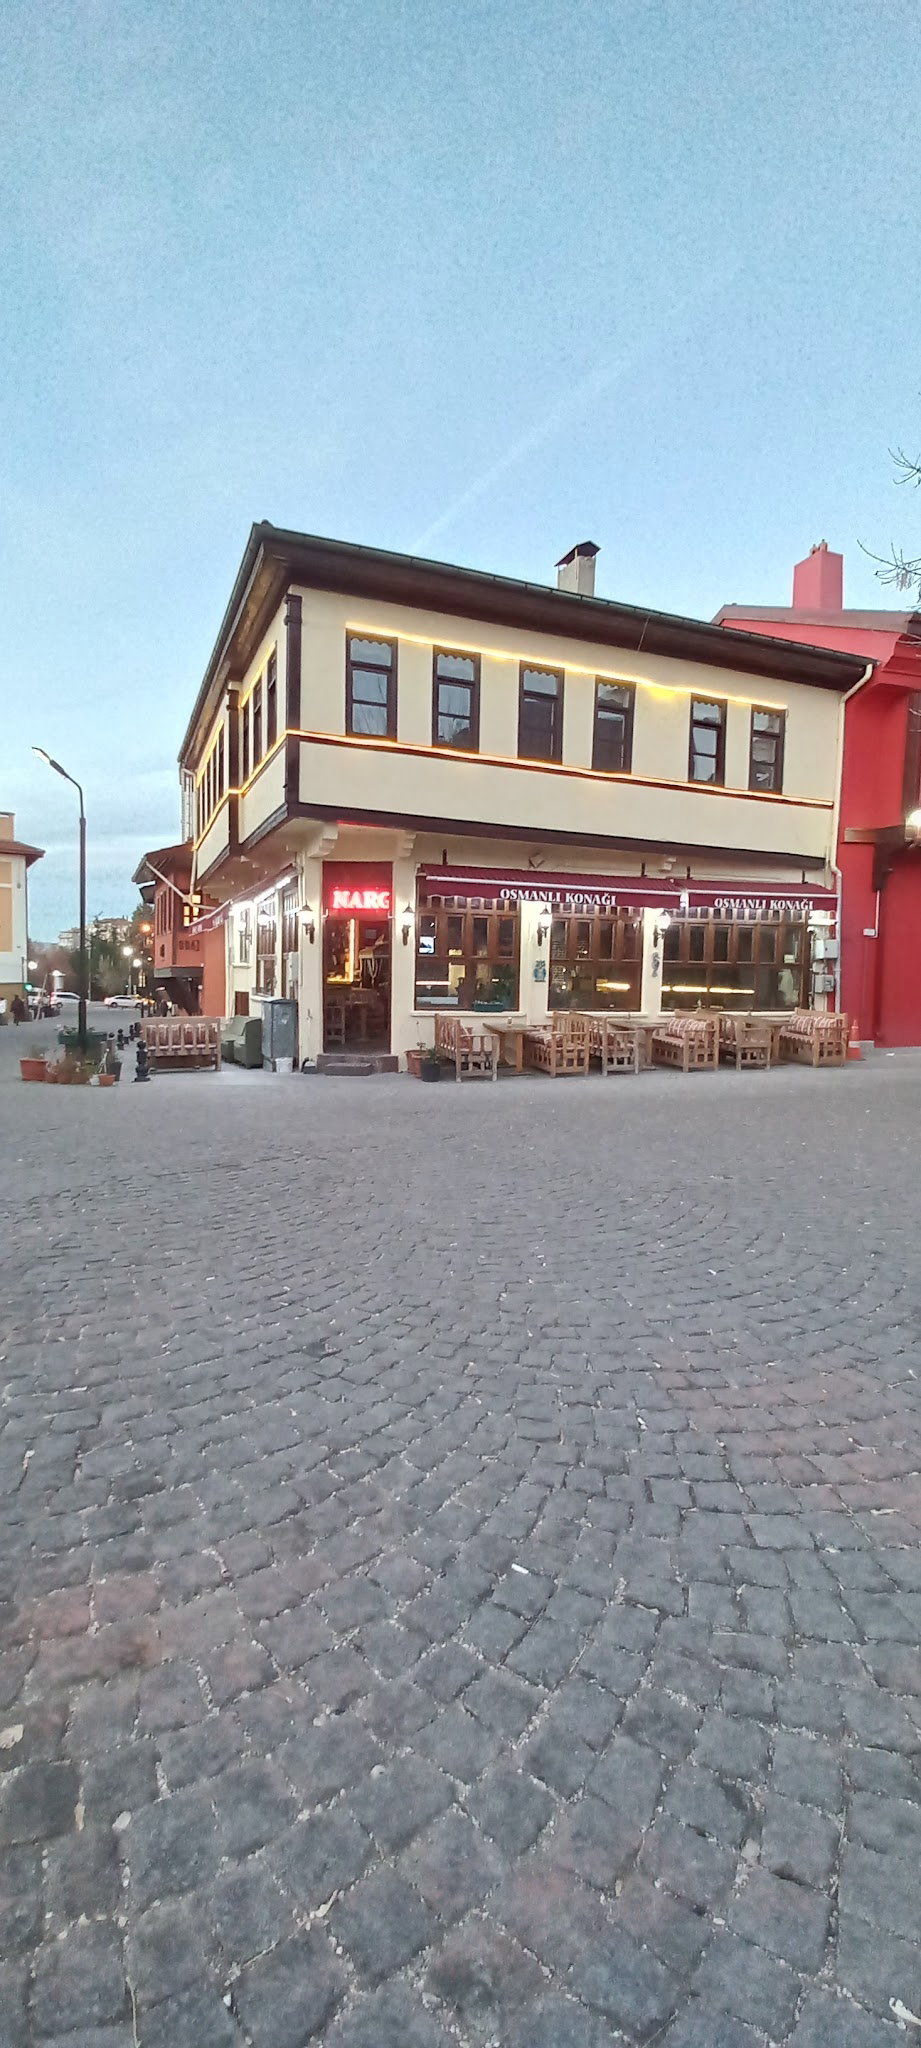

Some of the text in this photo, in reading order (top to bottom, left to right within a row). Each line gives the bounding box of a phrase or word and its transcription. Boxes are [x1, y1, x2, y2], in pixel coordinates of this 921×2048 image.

[332, 890, 390, 909] NARG
[500, 888, 617, 906] OSMANLI KONAĞI
[714, 897, 814, 910] OSMANLI KONAĞI
